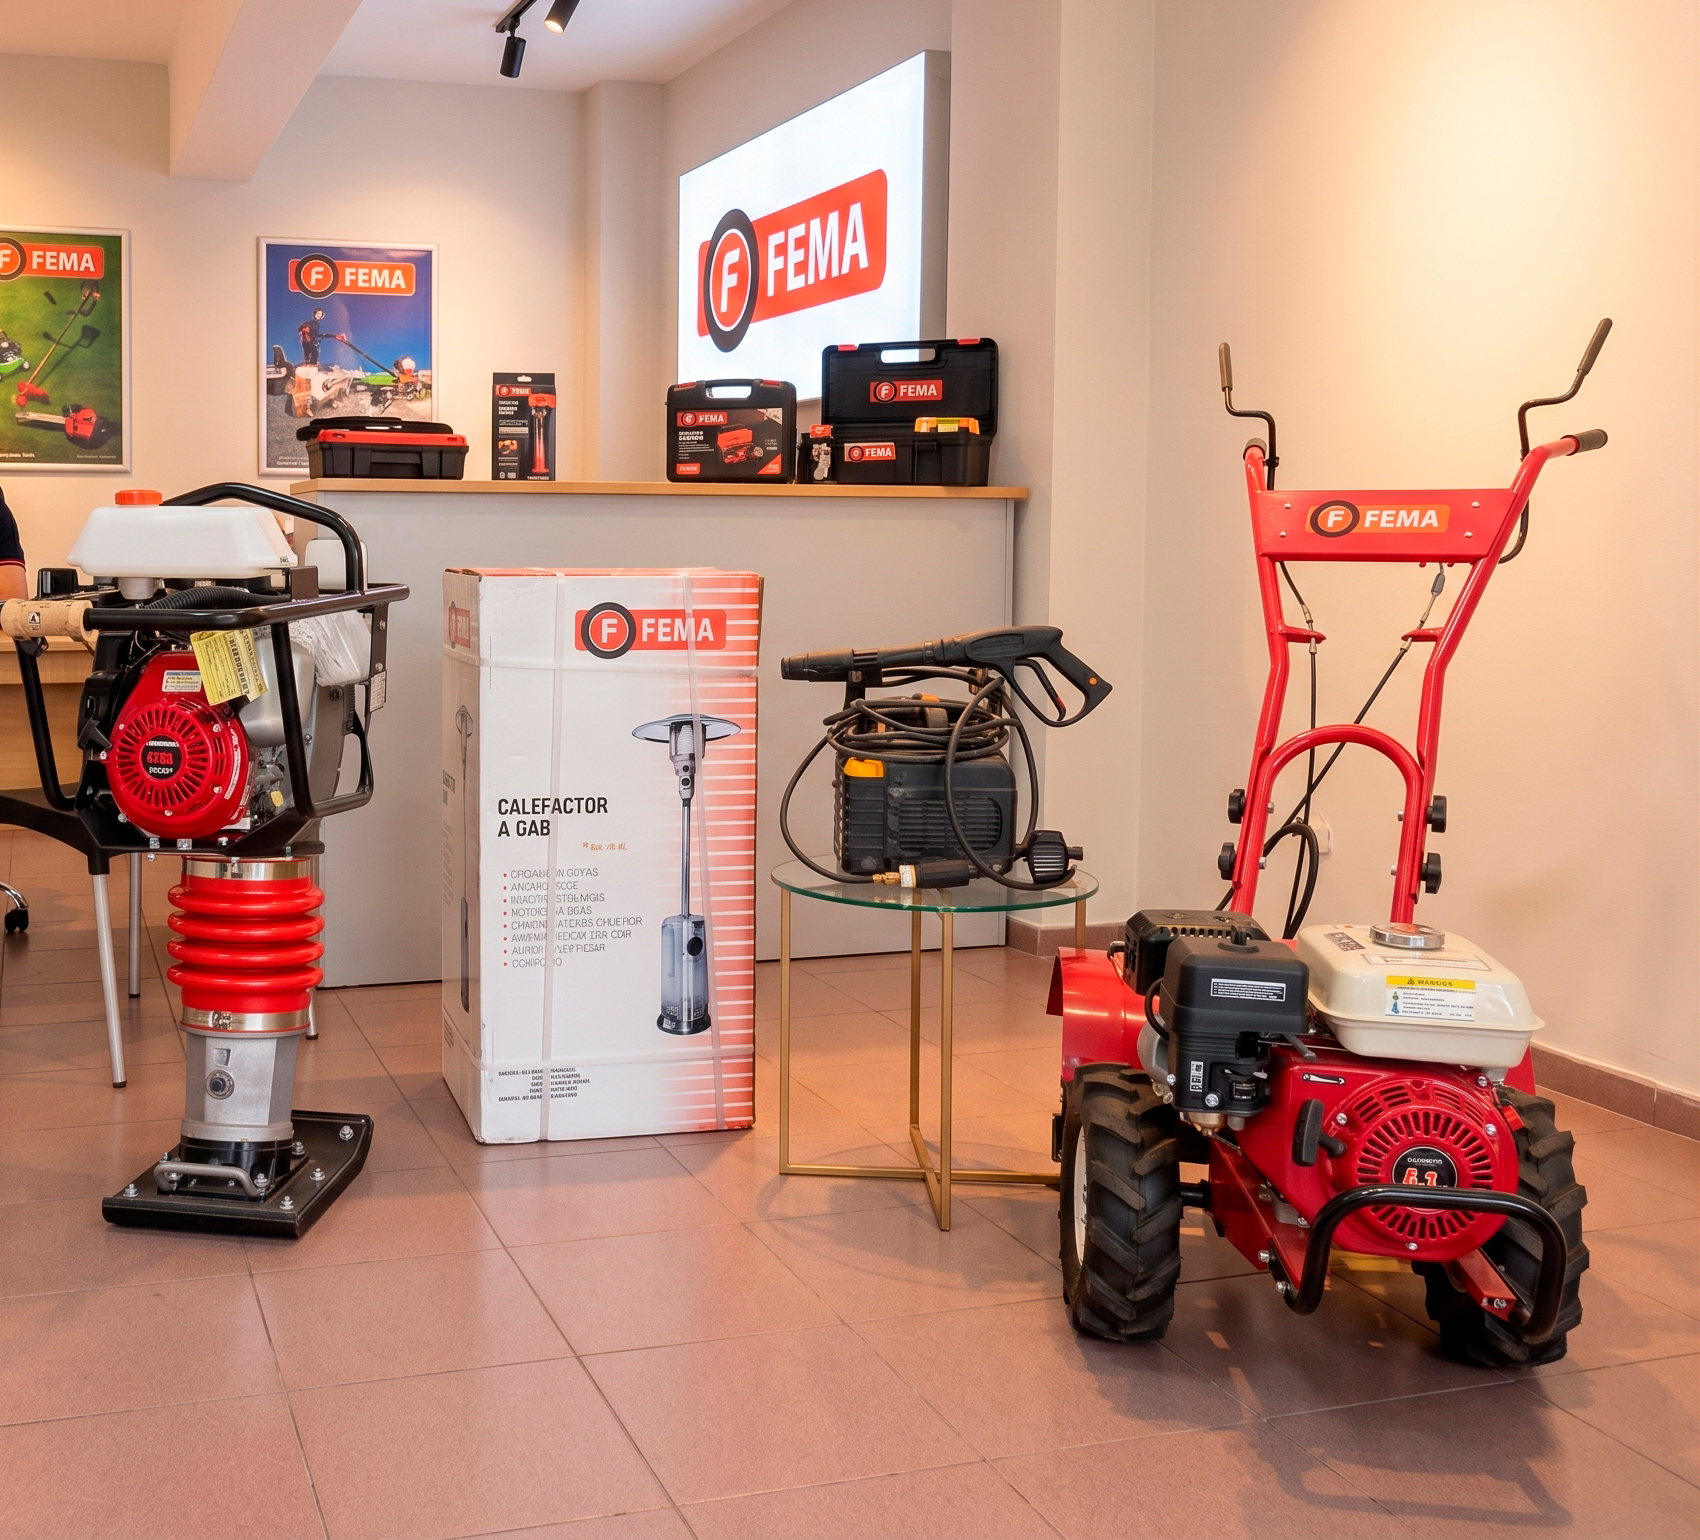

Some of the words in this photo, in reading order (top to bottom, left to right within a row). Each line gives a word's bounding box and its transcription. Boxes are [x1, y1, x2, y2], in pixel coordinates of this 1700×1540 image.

[32, 250, 95, 272] FEMA
[720, 247, 741, 313] F
[767, 201, 869, 297] FEMA
[310, 266, 325, 286] F
[345, 267, 406, 289] FEMA
[900, 384, 937, 397] FEMA
[699, 414, 724, 423] FEMA
[865, 447, 892, 458] FEMA
[1327, 510, 1344, 528] F
[1364, 510, 1439, 528] FEMA
[601, 618, 618, 644] F
[642, 617, 715, 642] FEMA
[498, 796, 608, 815] CALEFACTOR
[497, 820, 510, 837] A
[516, 819, 550, 837] GAB
